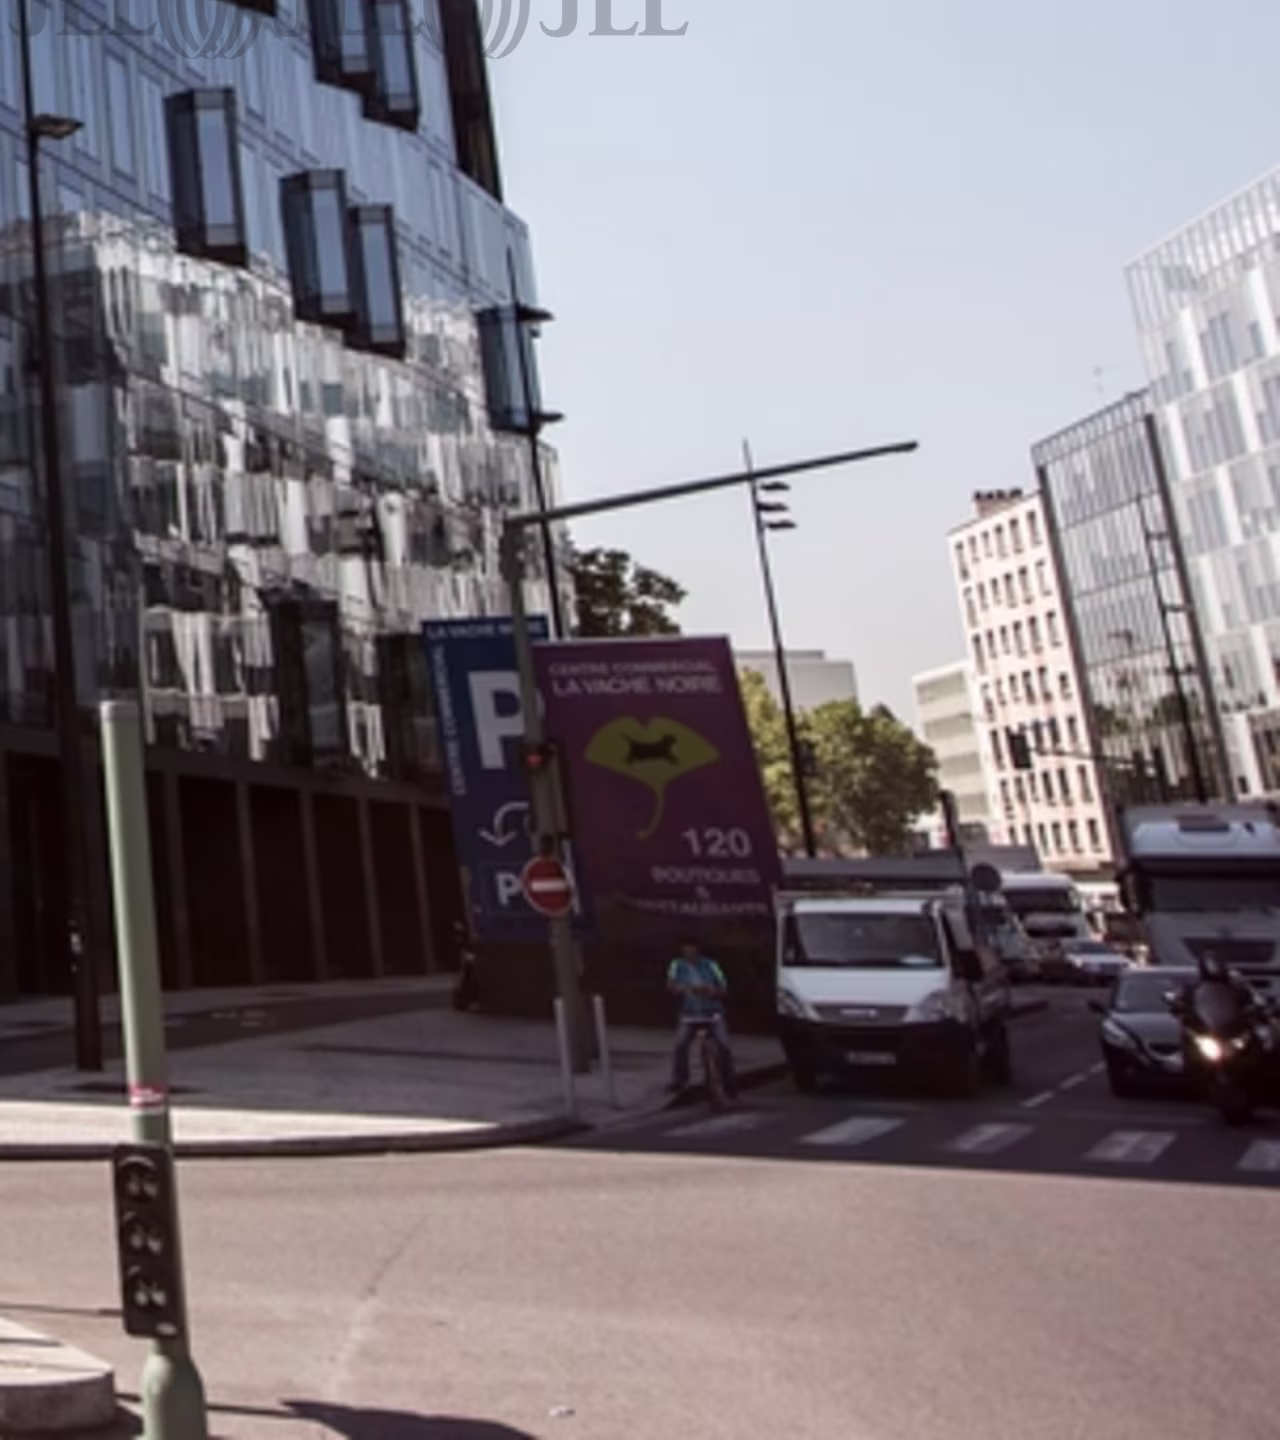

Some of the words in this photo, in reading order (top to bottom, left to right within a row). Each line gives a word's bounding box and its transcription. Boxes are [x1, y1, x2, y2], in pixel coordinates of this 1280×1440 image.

[552, 677, 582, 696] LA
[583, 676, 652, 695] VACHE
[654, 675, 721, 694] NOIRE
[681, 825, 752, 858] 120
